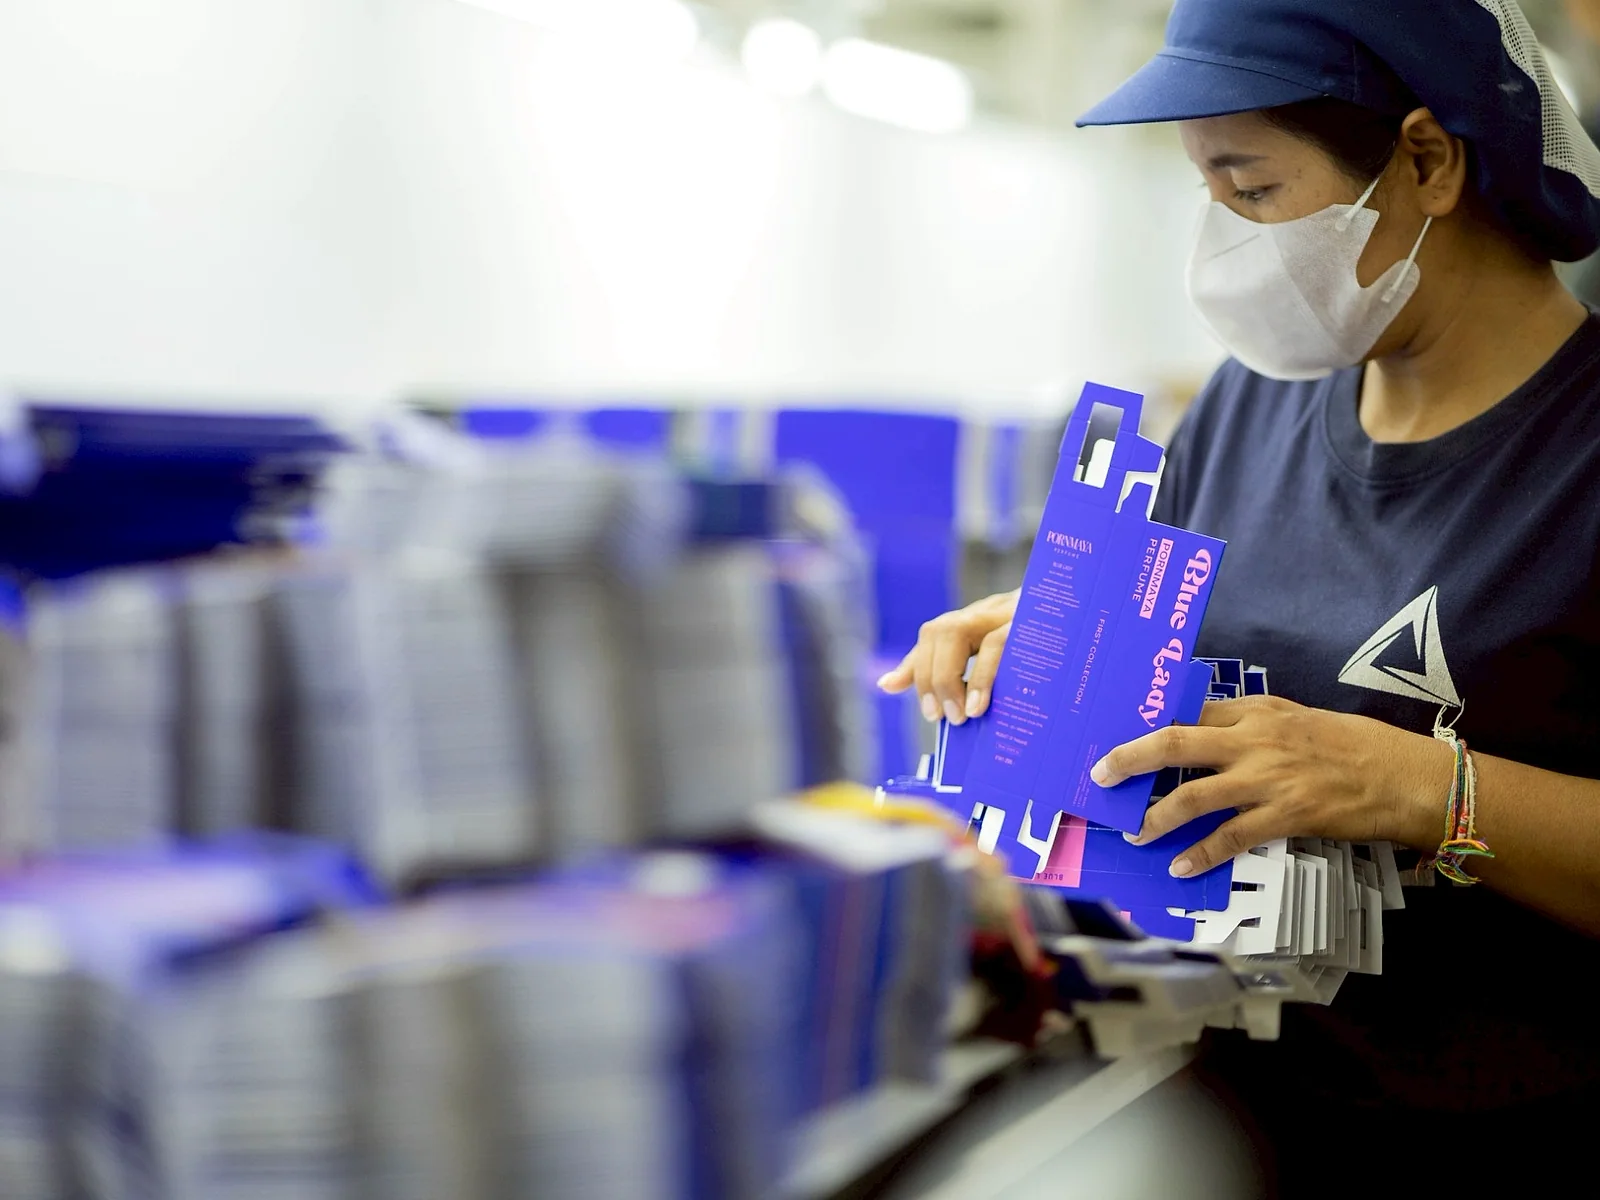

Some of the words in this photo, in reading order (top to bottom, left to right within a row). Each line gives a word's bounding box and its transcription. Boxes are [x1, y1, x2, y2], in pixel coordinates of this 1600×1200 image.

[1046, 530, 1093, 555] PORNMAYA
[1132, 538, 1158, 602] PERFUME
[1142, 542, 1171, 613] PORNMAYA
[1169, 548, 1212, 630] Blue
[1093, 618, 1106, 644] FIRST
[1074, 646, 1097, 705] COLLECTION
[1138, 638, 1184, 727] Lady
[1044, 873, 1064, 881] BLUE
